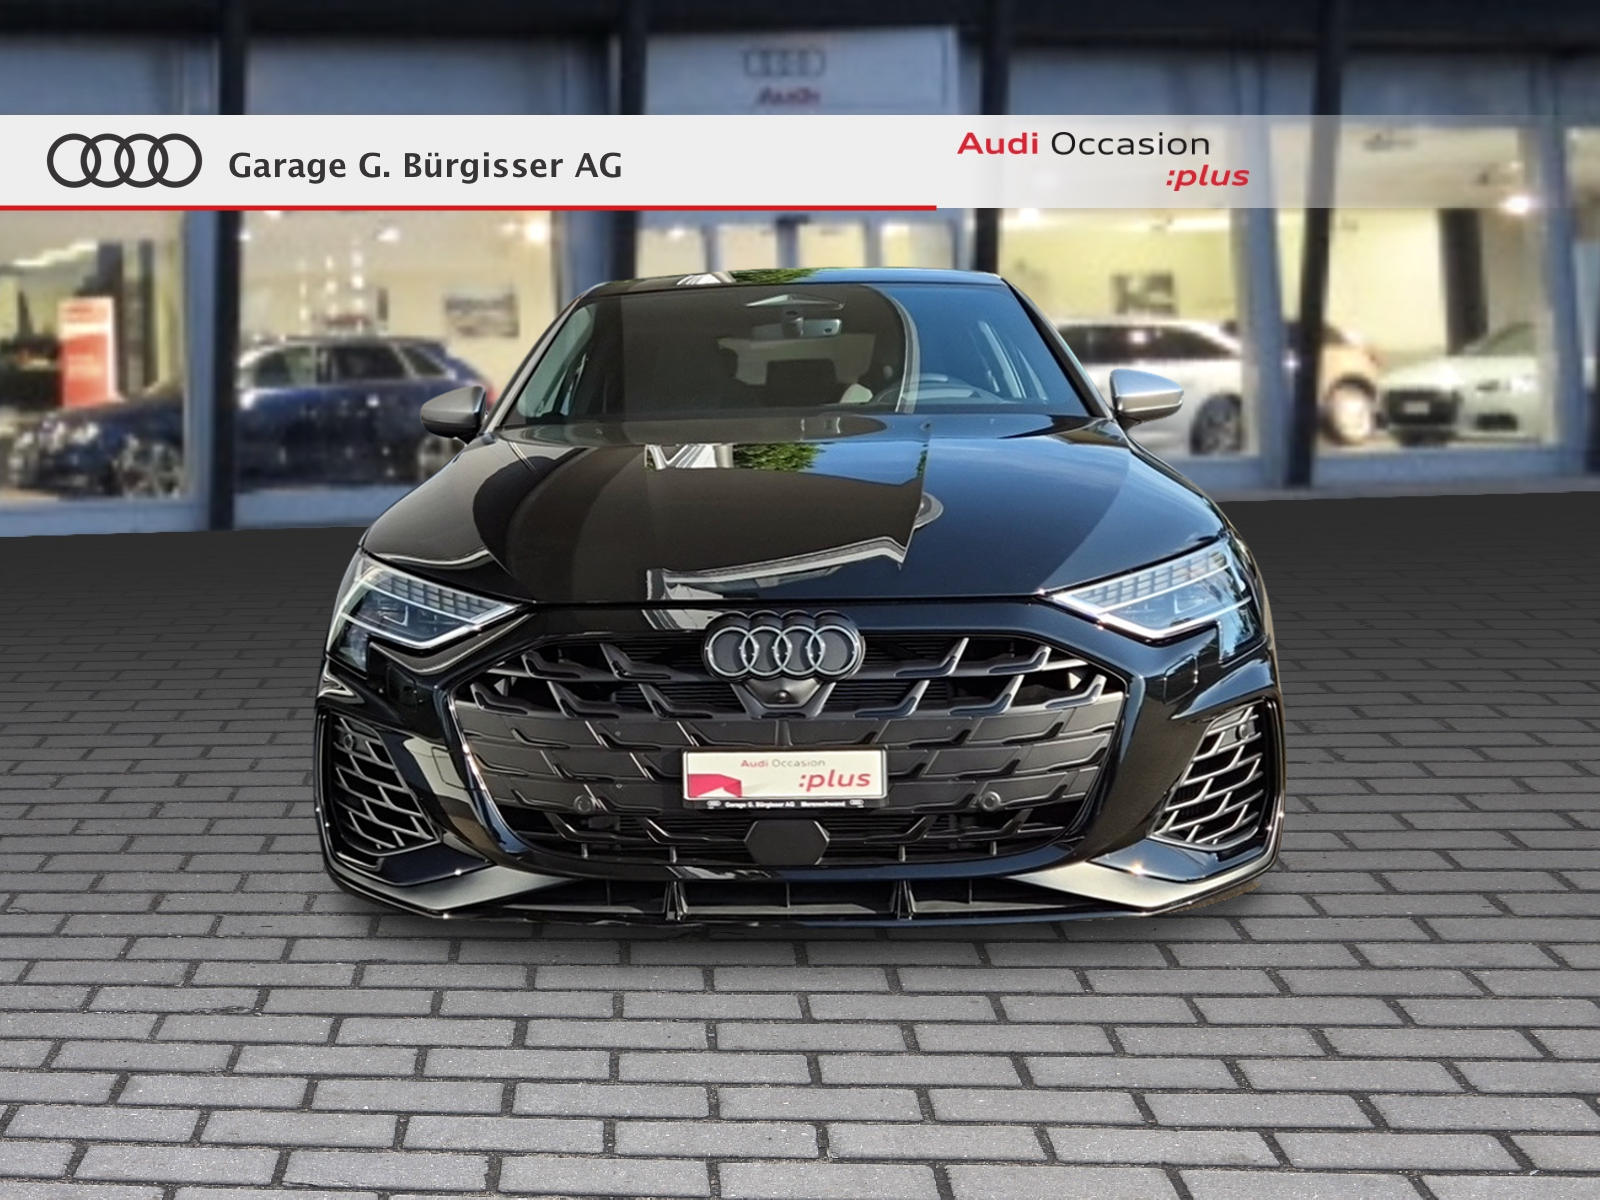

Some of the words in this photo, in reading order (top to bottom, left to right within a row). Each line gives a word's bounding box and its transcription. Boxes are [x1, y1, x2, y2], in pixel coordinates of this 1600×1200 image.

[740, 759, 769, 768] Audi
[771, 758, 826, 768] Occasion
[798, 769, 871, 792] :plus
